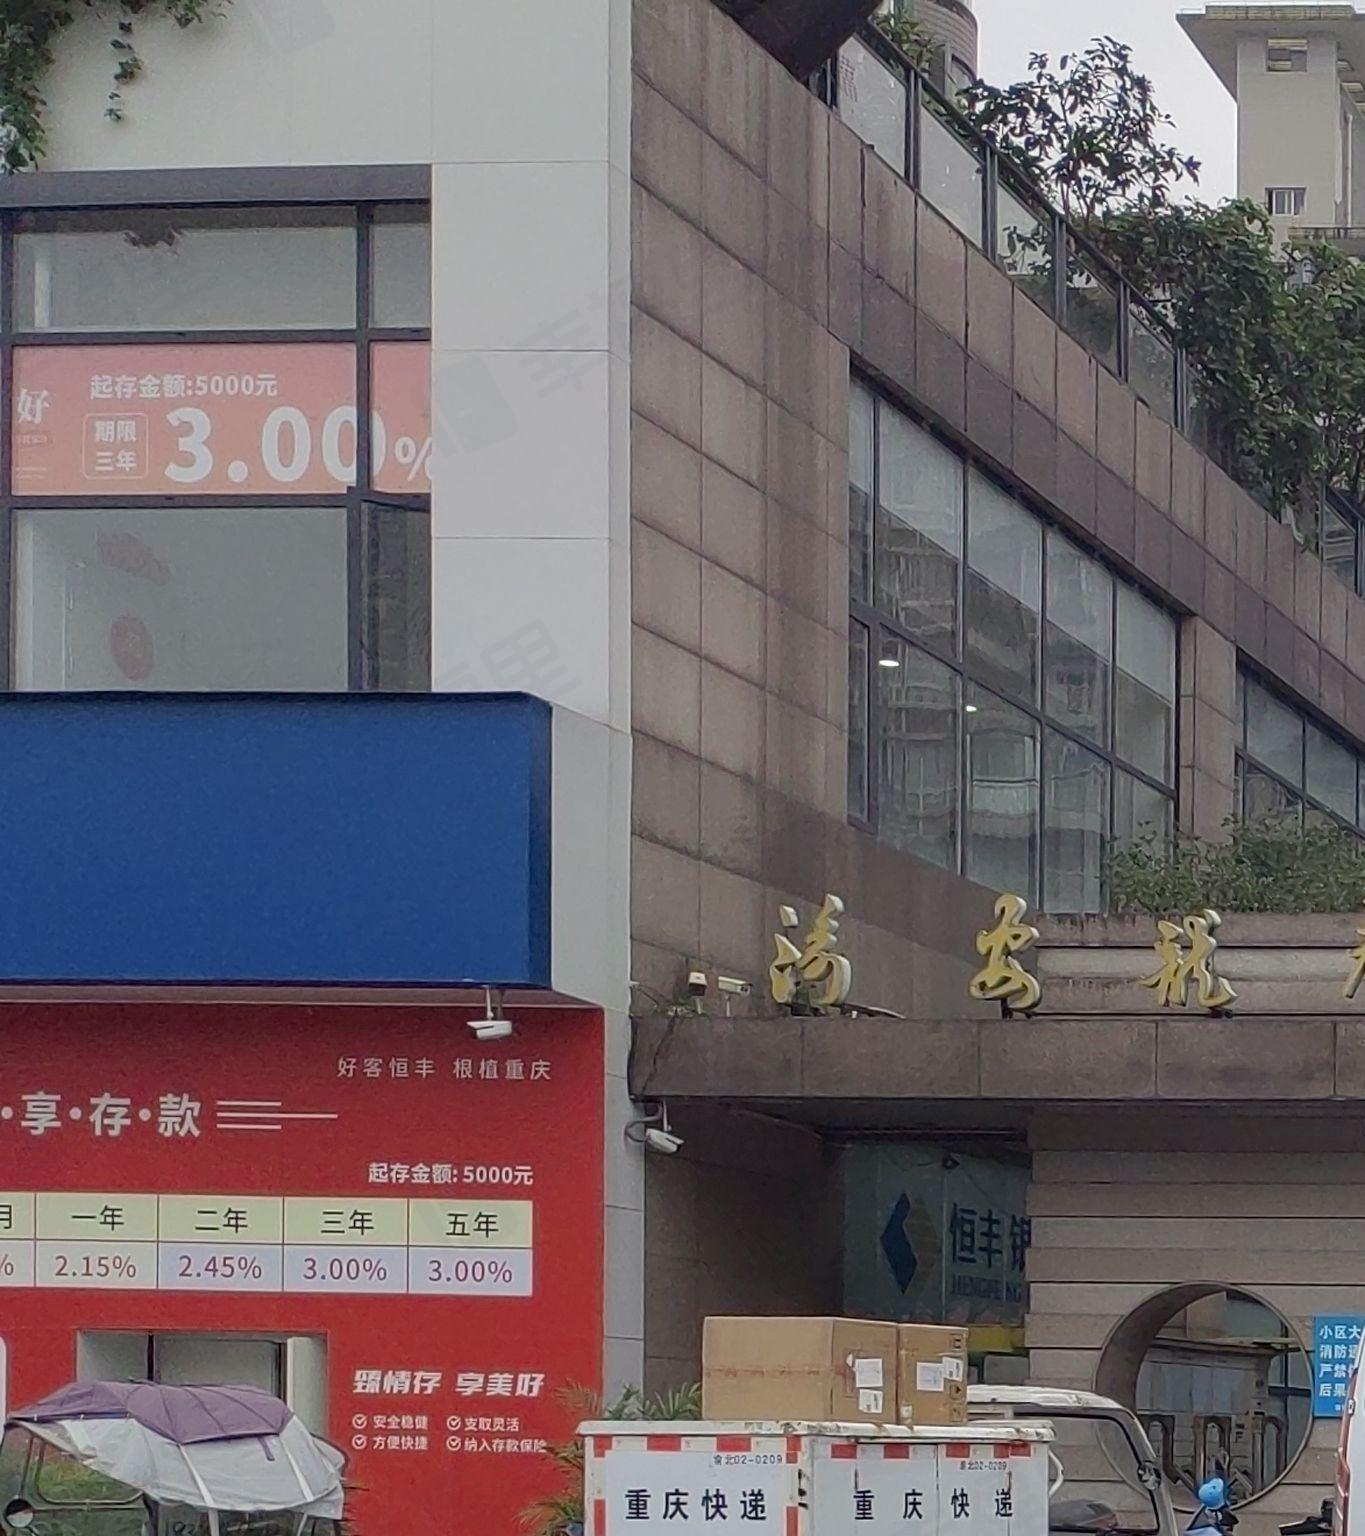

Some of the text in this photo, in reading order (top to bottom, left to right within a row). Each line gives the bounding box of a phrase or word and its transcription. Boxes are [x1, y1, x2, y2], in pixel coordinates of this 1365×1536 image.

[94, 420, 137, 443] 期限
[94, 450, 137, 472] 三年
[337, 1058, 551, 1081] 好客恒丰 根植重庆
[71, 1205, 125, 1231] 一年
[194, 1207, 248, 1234] 二年
[320, 1209, 374, 1236] 三年
[445, 1211, 499, 1238] 五年
[54, 1255, 137, 1278] 2.15%
[178, 1256, 262, 1280] 2.45%
[303, 1258, 388, 1281] 3.00%
[428, 1260, 513, 1284] 3.00%
[455, 1373, 545, 1397] 享美好
[373, 1415, 429, 1429] 安全稳健
[464, 1417, 520, 1432] 支取灵活
[373, 1436, 428, 1450] 方便快捷
[625, 1488, 767, 1521] 重庆快递
[853, 1487, 1013, 1521] 重庆快递
